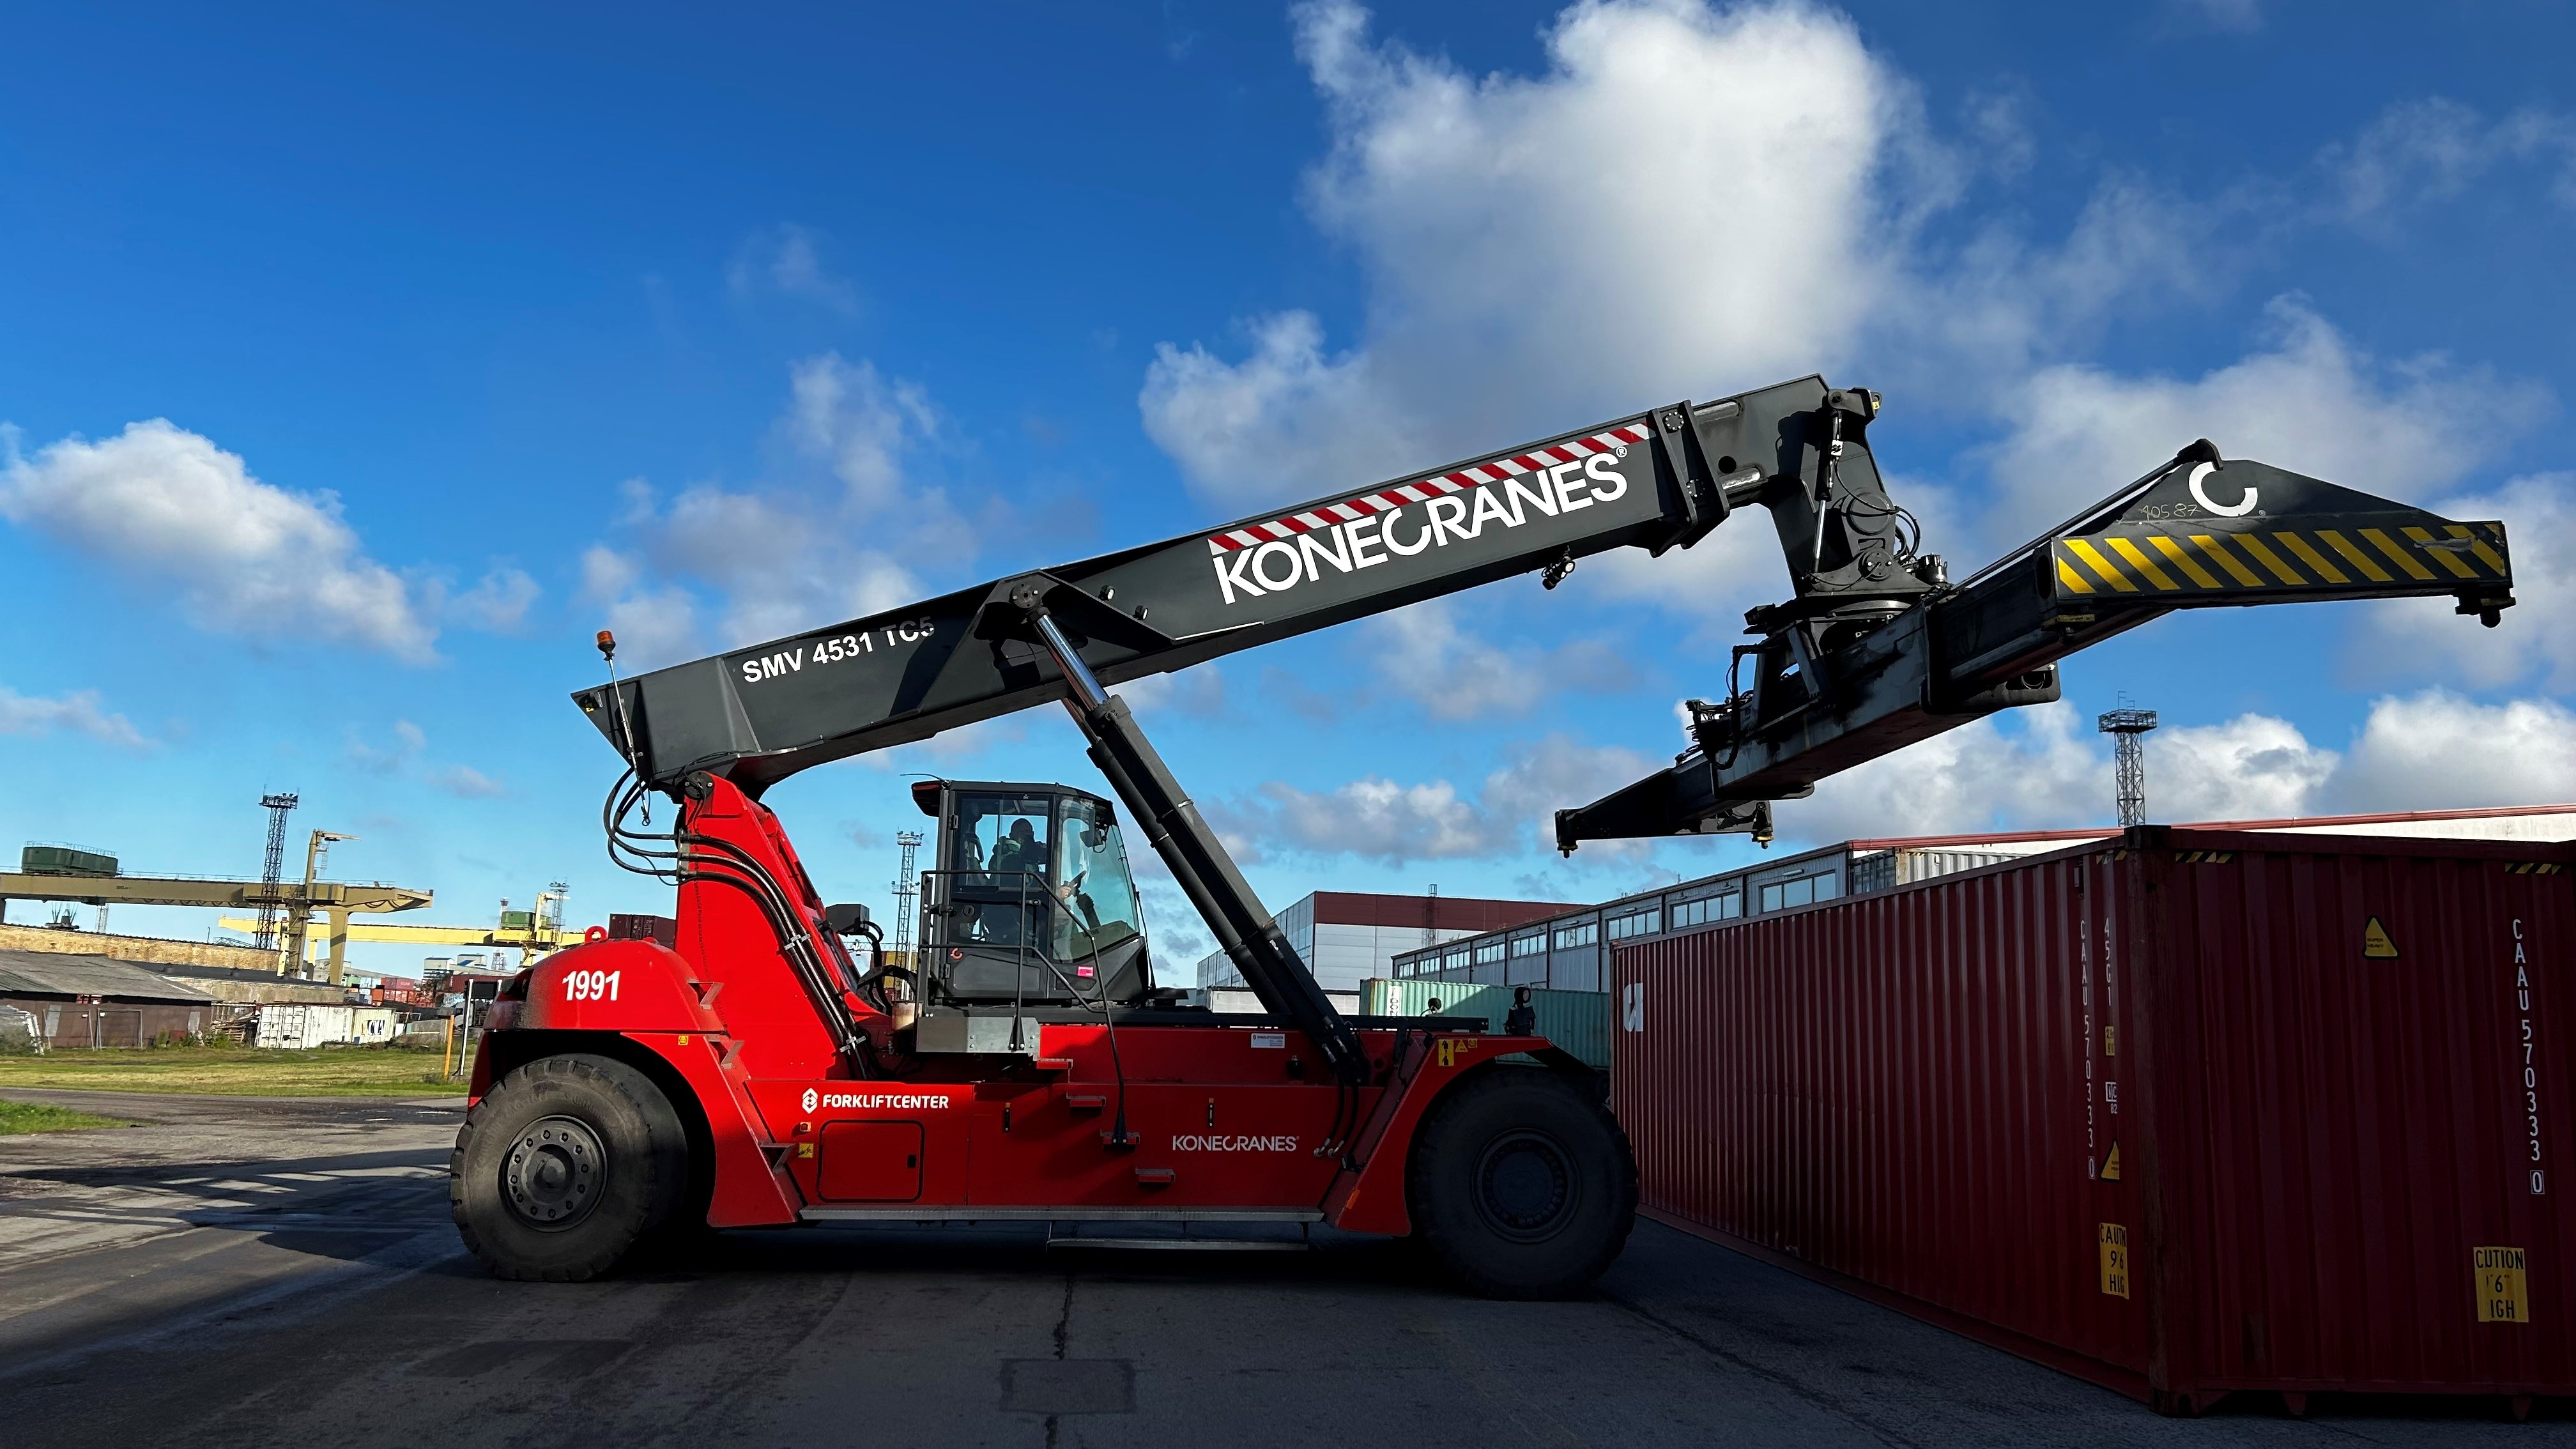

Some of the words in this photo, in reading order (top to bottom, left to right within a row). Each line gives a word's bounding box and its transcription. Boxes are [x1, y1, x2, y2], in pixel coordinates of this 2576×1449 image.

[743, 648, 802, 682] SMV
[813, 632, 873, 664] 4531
[879, 615, 935, 647] TC5
[563, 970, 620, 1000] 1991
[2512, 919, 2529, 1011] CAAU
[2521, 1019, 2541, 1162] 570333
[822, 1094, 949, 1108] FORKLIFTCENTER
